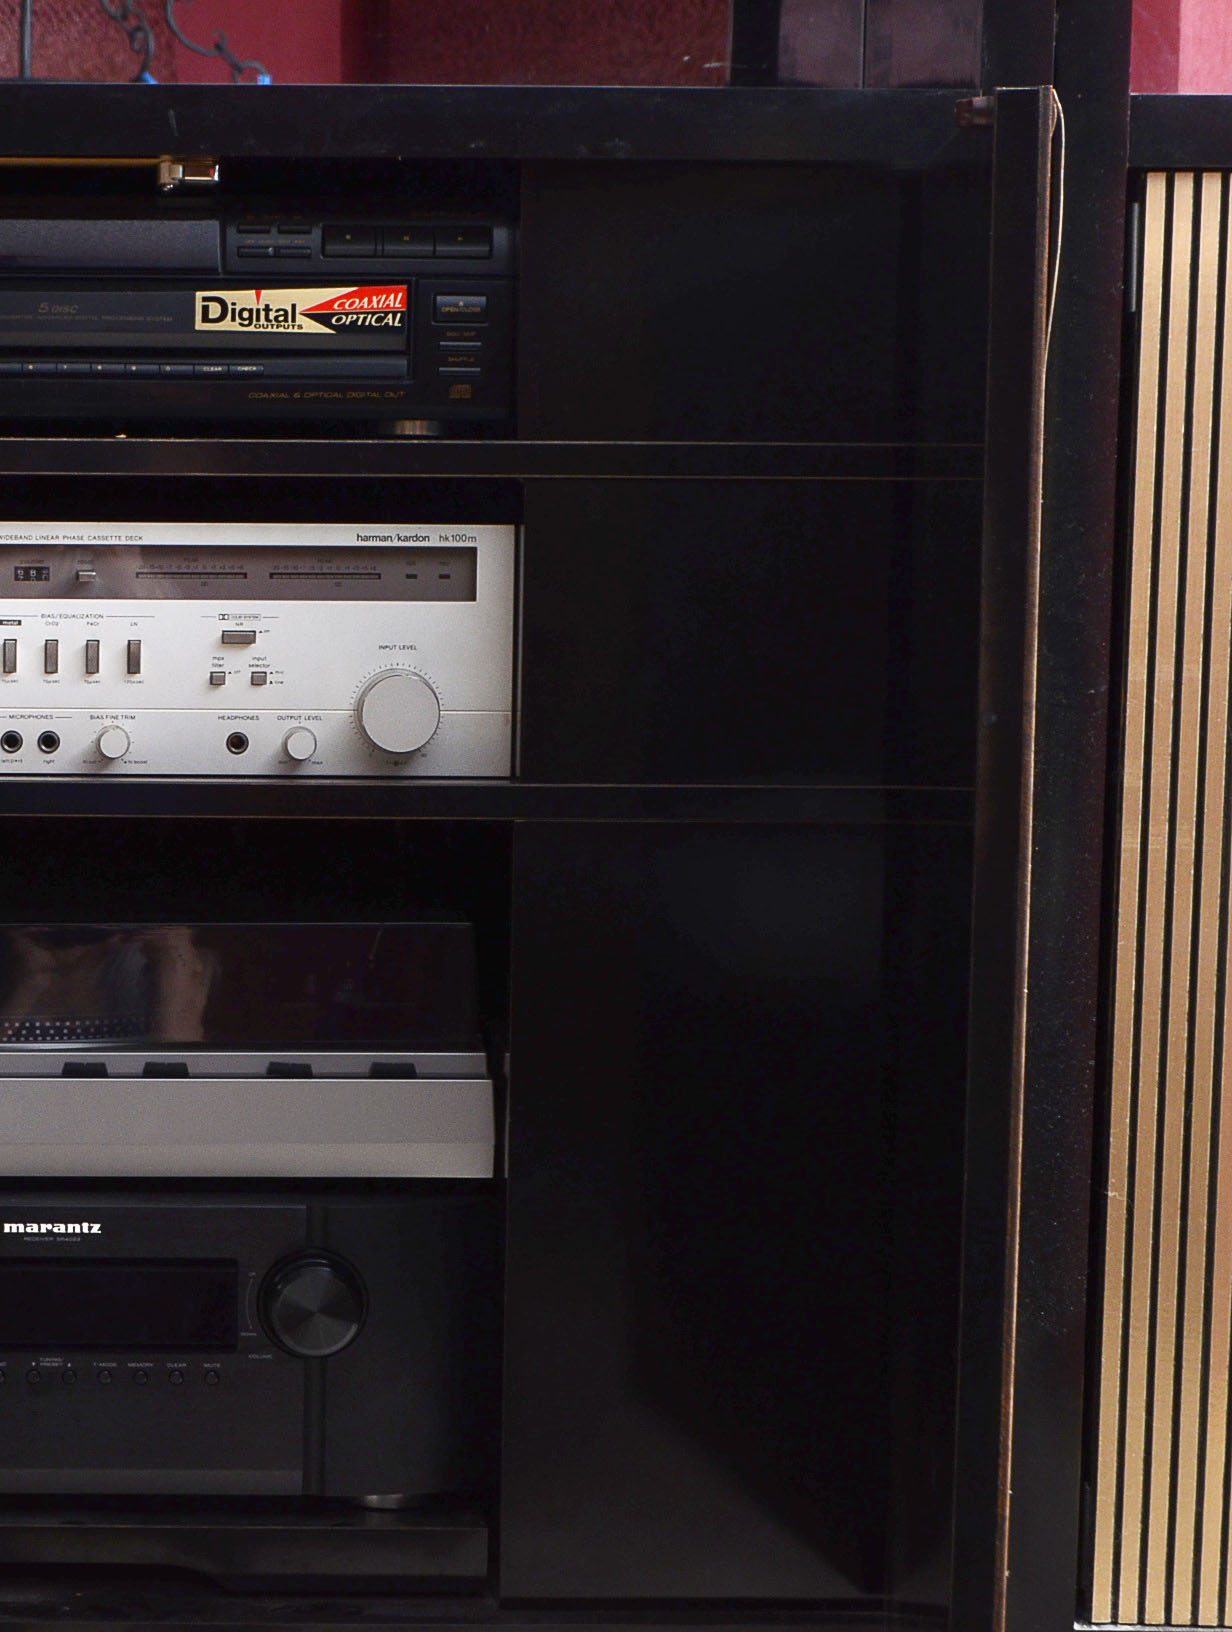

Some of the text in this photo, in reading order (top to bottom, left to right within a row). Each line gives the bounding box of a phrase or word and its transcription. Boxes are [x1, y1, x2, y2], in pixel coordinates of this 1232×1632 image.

[332, 292, 403, 311] COAXIAL
[37, 302, 51, 314] 5
[201, 296, 297, 327] Digital
[331, 312, 402, 327] OPTICAL
[248, 391, 290, 400] COAXIAL
[303, 391, 344, 400] OPTICAL
[346, 391, 381, 400] DIGITAL
[383, 391, 406, 400] OUT
[35, 534, 61, 542] LINEAR
[62, 534, 85, 542] PHASE
[87, 534, 123, 542] CASSETTE
[125, 534, 144, 542] DECK
[356, 533, 431, 544] harman/kardon
[378, 644, 417, 652] INPUT LEVEL
[217, 714, 259, 722] HEADPHONES
[276, 714, 322, 722] OUTPUT LEVEL
[3, 1222, 101, 1234] marantz
